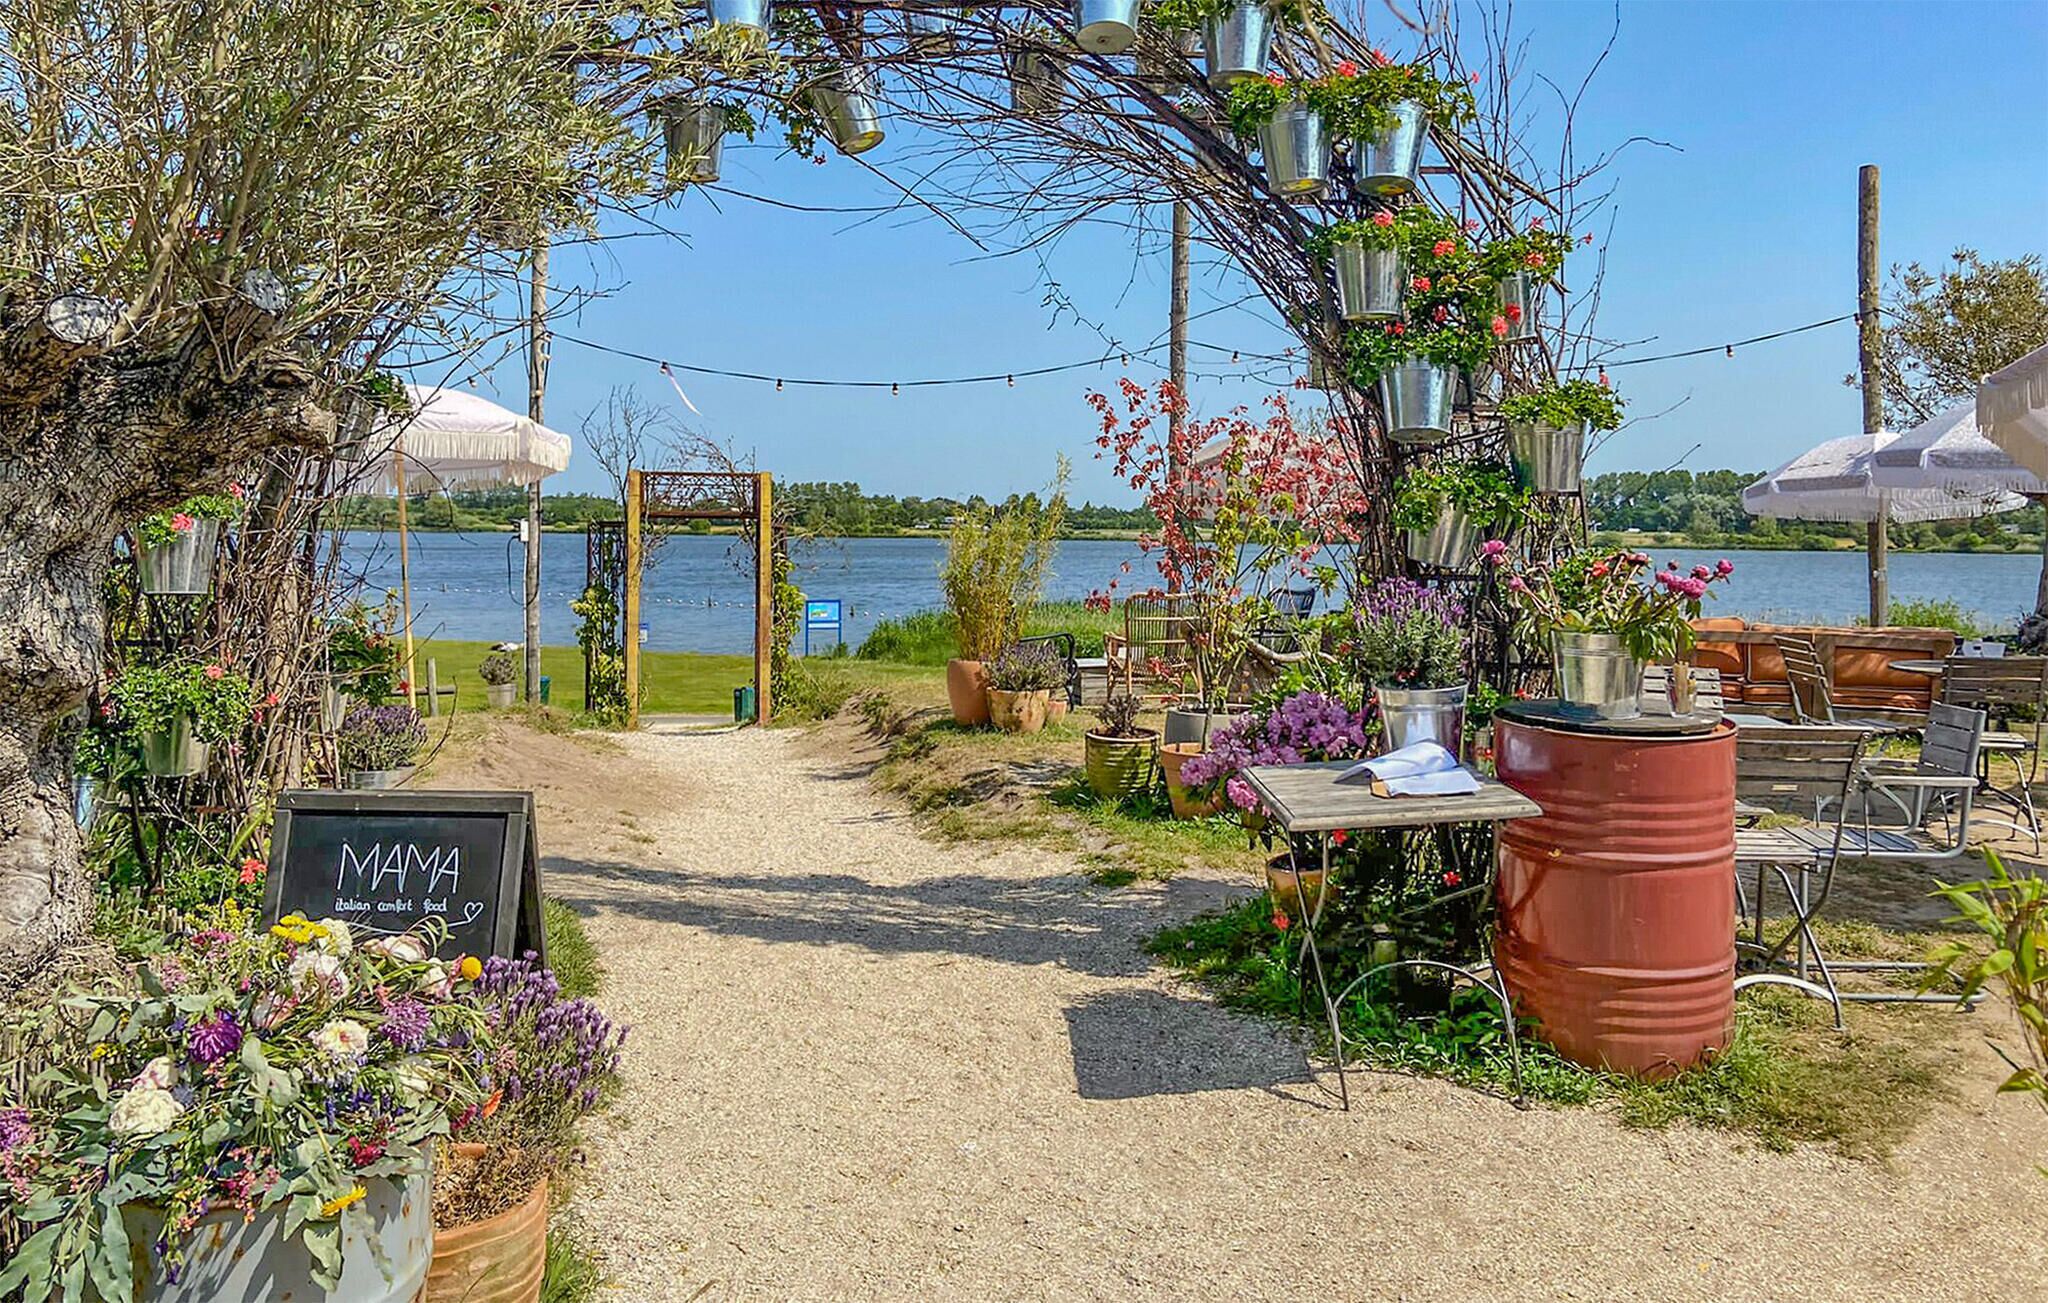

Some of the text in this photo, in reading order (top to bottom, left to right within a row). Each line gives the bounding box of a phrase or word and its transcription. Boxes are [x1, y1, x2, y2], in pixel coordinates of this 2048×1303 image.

[336, 841, 460, 895] MAMA
[335, 894, 371, 912] italian
[423, 897, 447, 914] food
